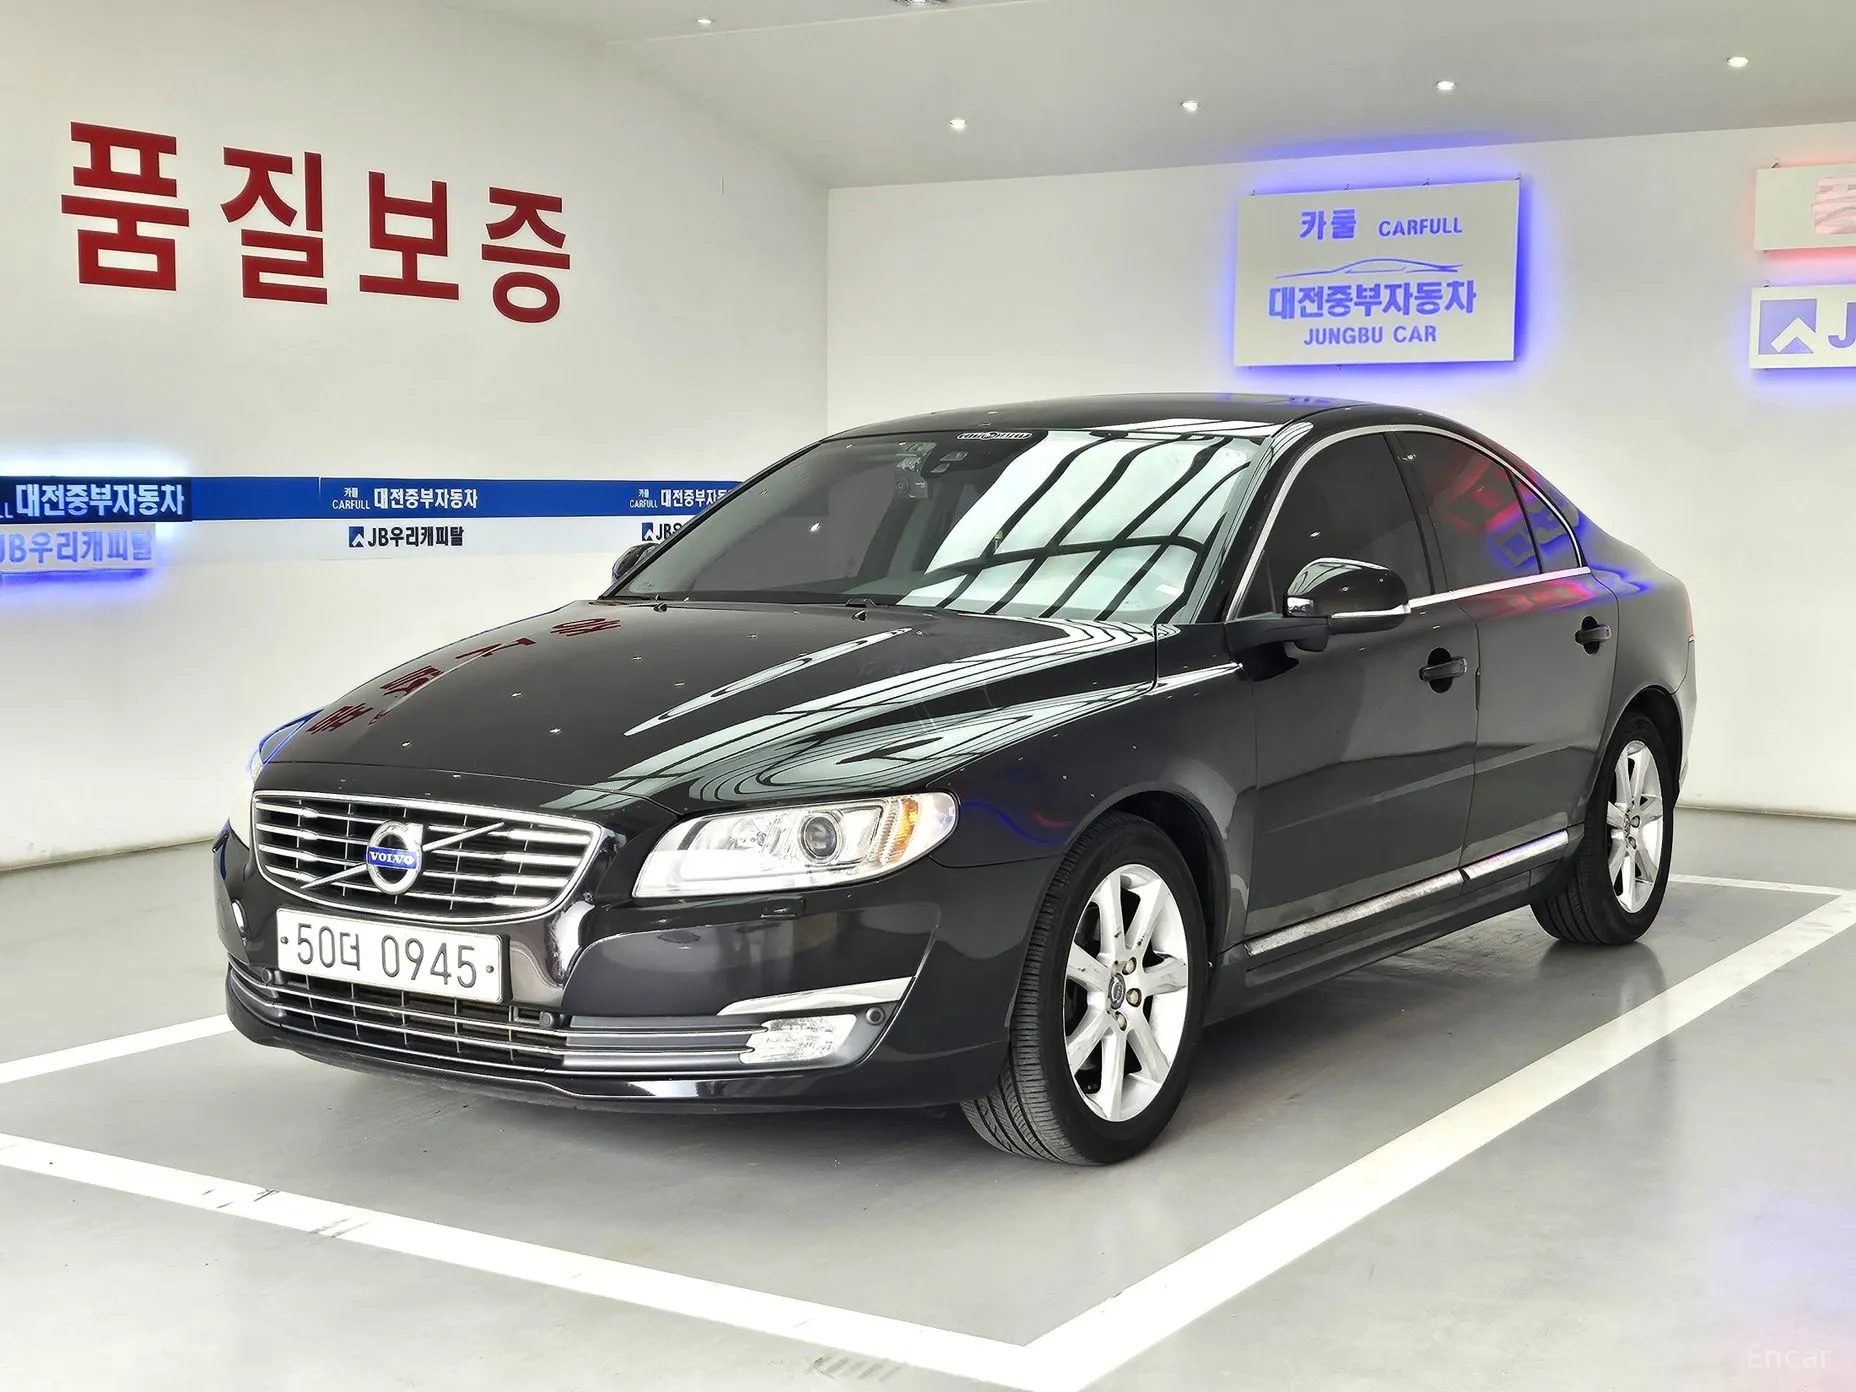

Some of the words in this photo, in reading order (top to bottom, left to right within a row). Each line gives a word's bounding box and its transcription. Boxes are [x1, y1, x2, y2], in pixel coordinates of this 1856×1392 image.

[1378, 217, 1463, 237] CARFULL
[1268, 280, 1477, 319] 대전중부자동차
[1304, 326, 1383, 345] JUNGBU
[1393, 325, 1436, 343] CAR
[15, 484, 184, 517] 대전중부자동차
[332, 499, 370, 510] CARFULL
[374, 487, 478, 509] 대전중부자동차
[629, 500, 658, 509] CARFULL
[368, 526, 464, 547] JB우리캐피탈
[369, 850, 415, 866] VOLVO
[297, 923, 361, 971] 50더
[380, 934, 477, 989] 0945
